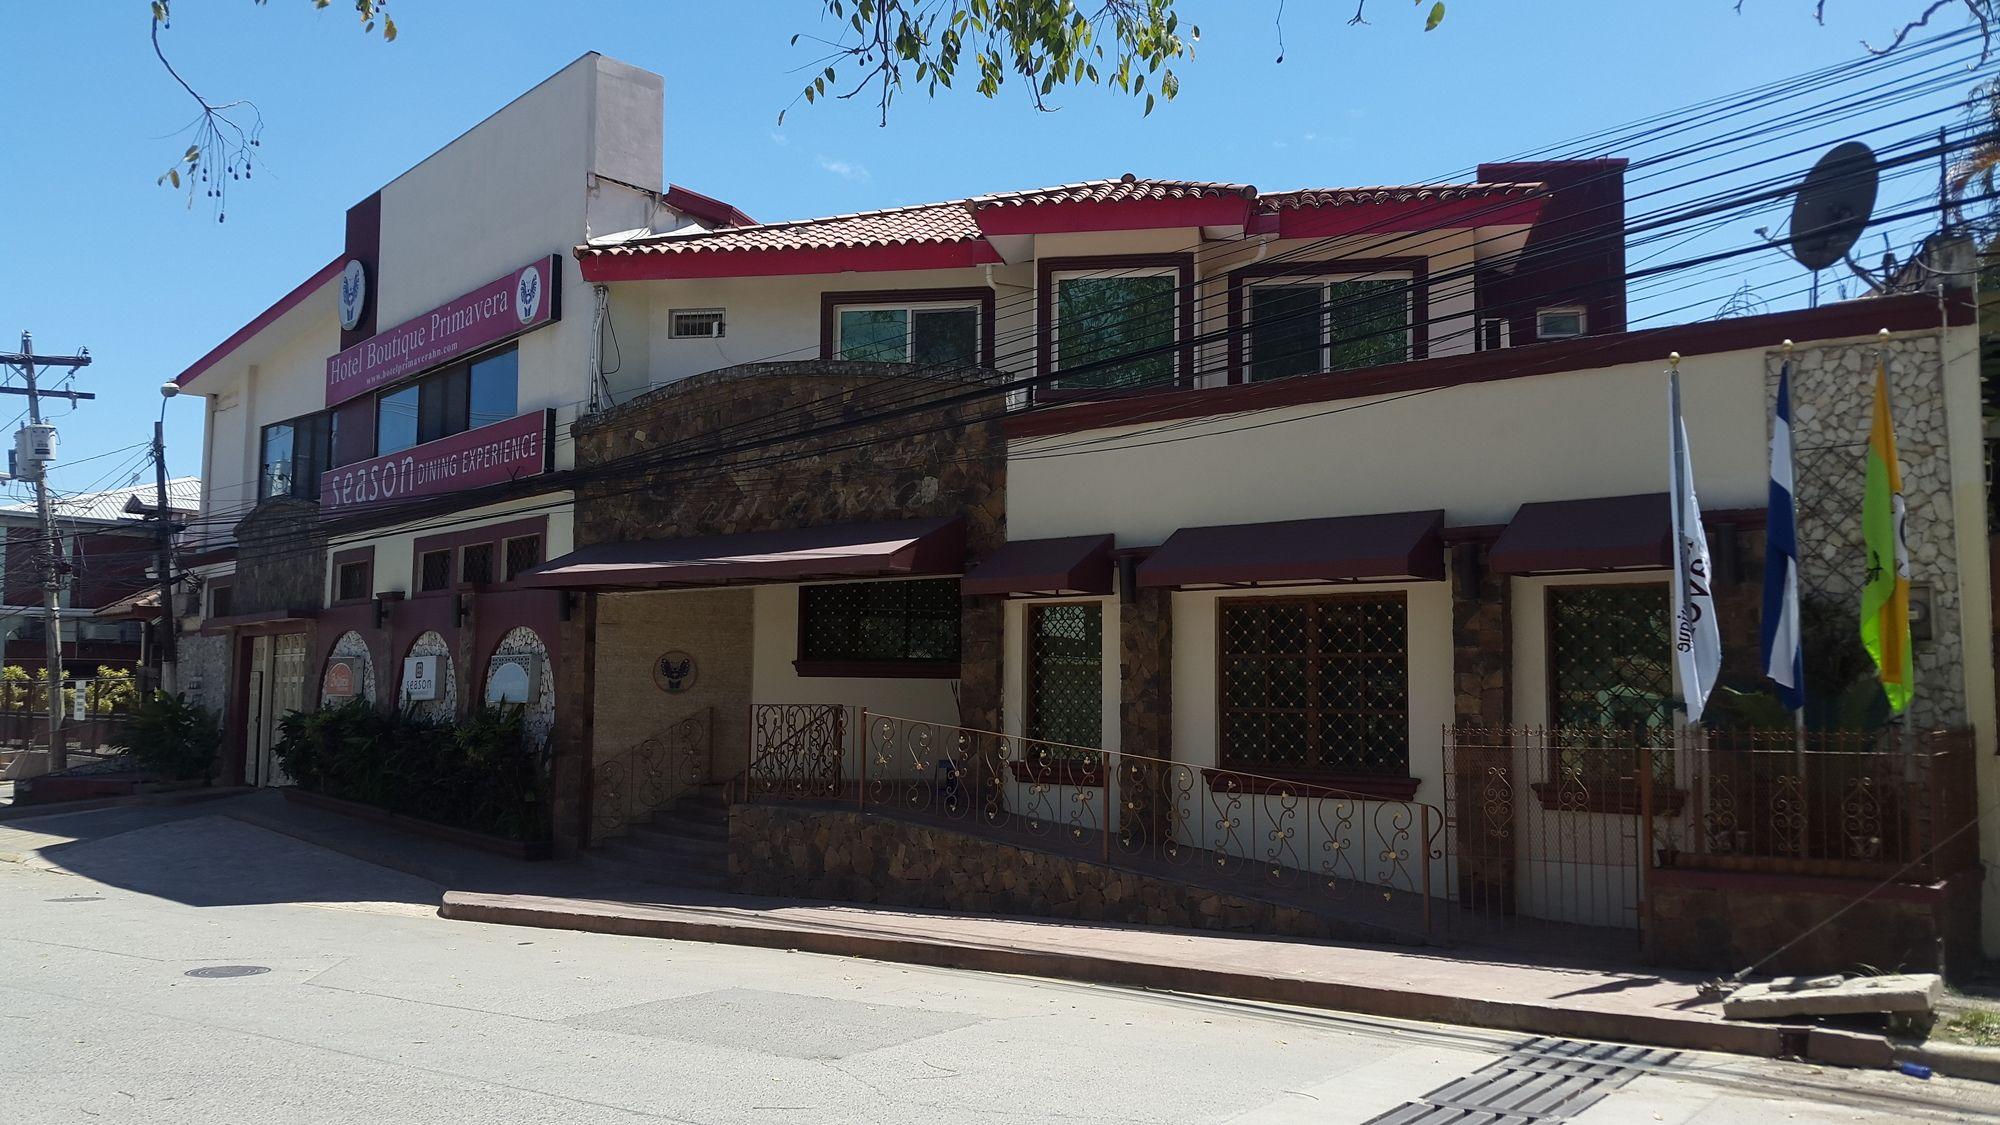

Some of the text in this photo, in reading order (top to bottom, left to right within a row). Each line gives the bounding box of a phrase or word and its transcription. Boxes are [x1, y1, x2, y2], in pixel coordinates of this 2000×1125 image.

[331, 290, 508, 385] Hotel Boutique Primavera
[366, 342, 459, 385] www.hotelprimaverahn.com
[331, 432, 537, 510] season DINING EXPERIENCE
[406, 679, 433, 690] season
